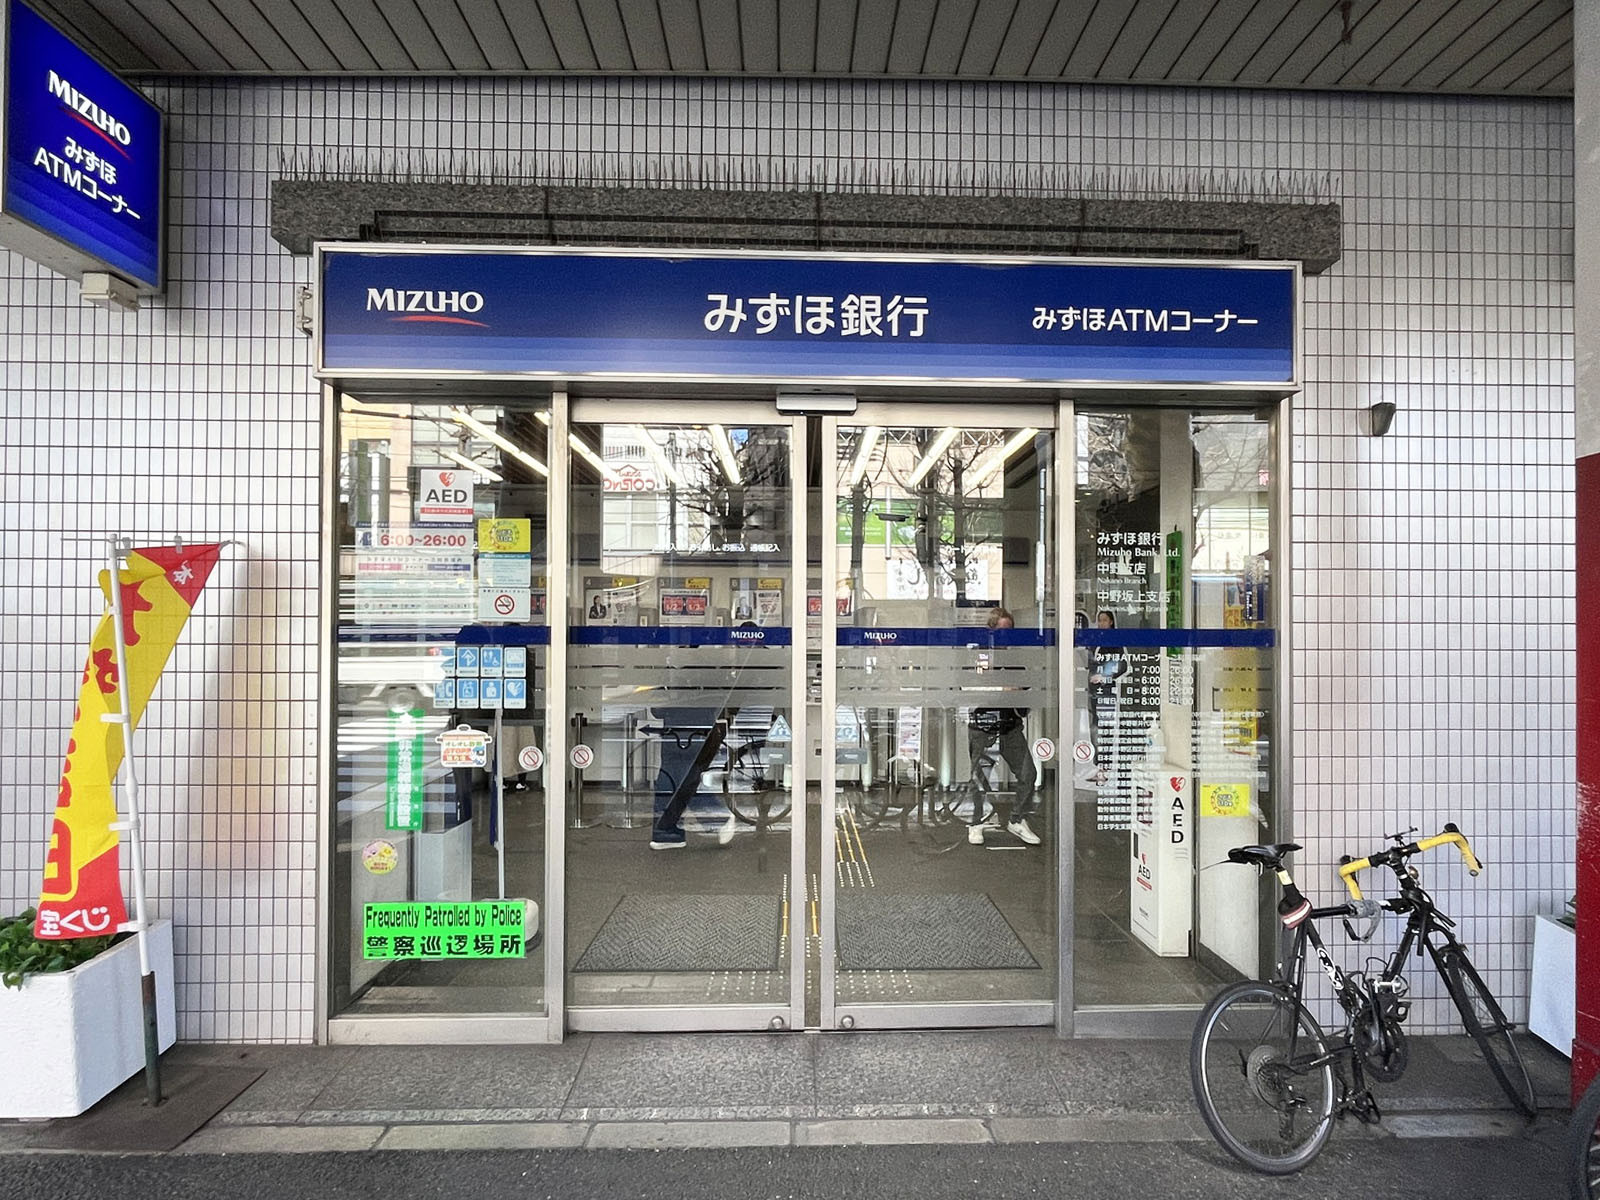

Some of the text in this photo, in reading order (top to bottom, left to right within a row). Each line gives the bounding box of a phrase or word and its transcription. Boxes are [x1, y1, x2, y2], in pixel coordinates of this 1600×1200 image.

[48, 69, 131, 146] MIZUHO
[64, 136, 117, 186] みずほ
[34, 147, 140, 220] ATMコーナー
[366, 288, 484, 312] MIZUHO
[703, 293, 929, 337] みずほ銀行
[1032, 306, 1258, 333] みずほATMコーナー
[426, 489, 467, 503] AED
[1097, 532, 1164, 546] みずほ銀行
[1097, 547, 1132, 557] Mizuho
[730, 630, 765, 639] MIZUHO
[1096, 653, 1164, 662] みずほATMコーナ
[1142, 666, 1160, 674] 7:00
[1142, 676, 1160, 684] 6:00
[1142, 687, 1160, 695] 8:00
[1142, 697, 1160, 705] 8:00
[1171, 797, 1184, 843] AED
[1138, 865, 1151, 879] AED
[39, 906, 111, 936] 宝くじ
[365, 904, 522, 928] Frequently Patrolled by Police
